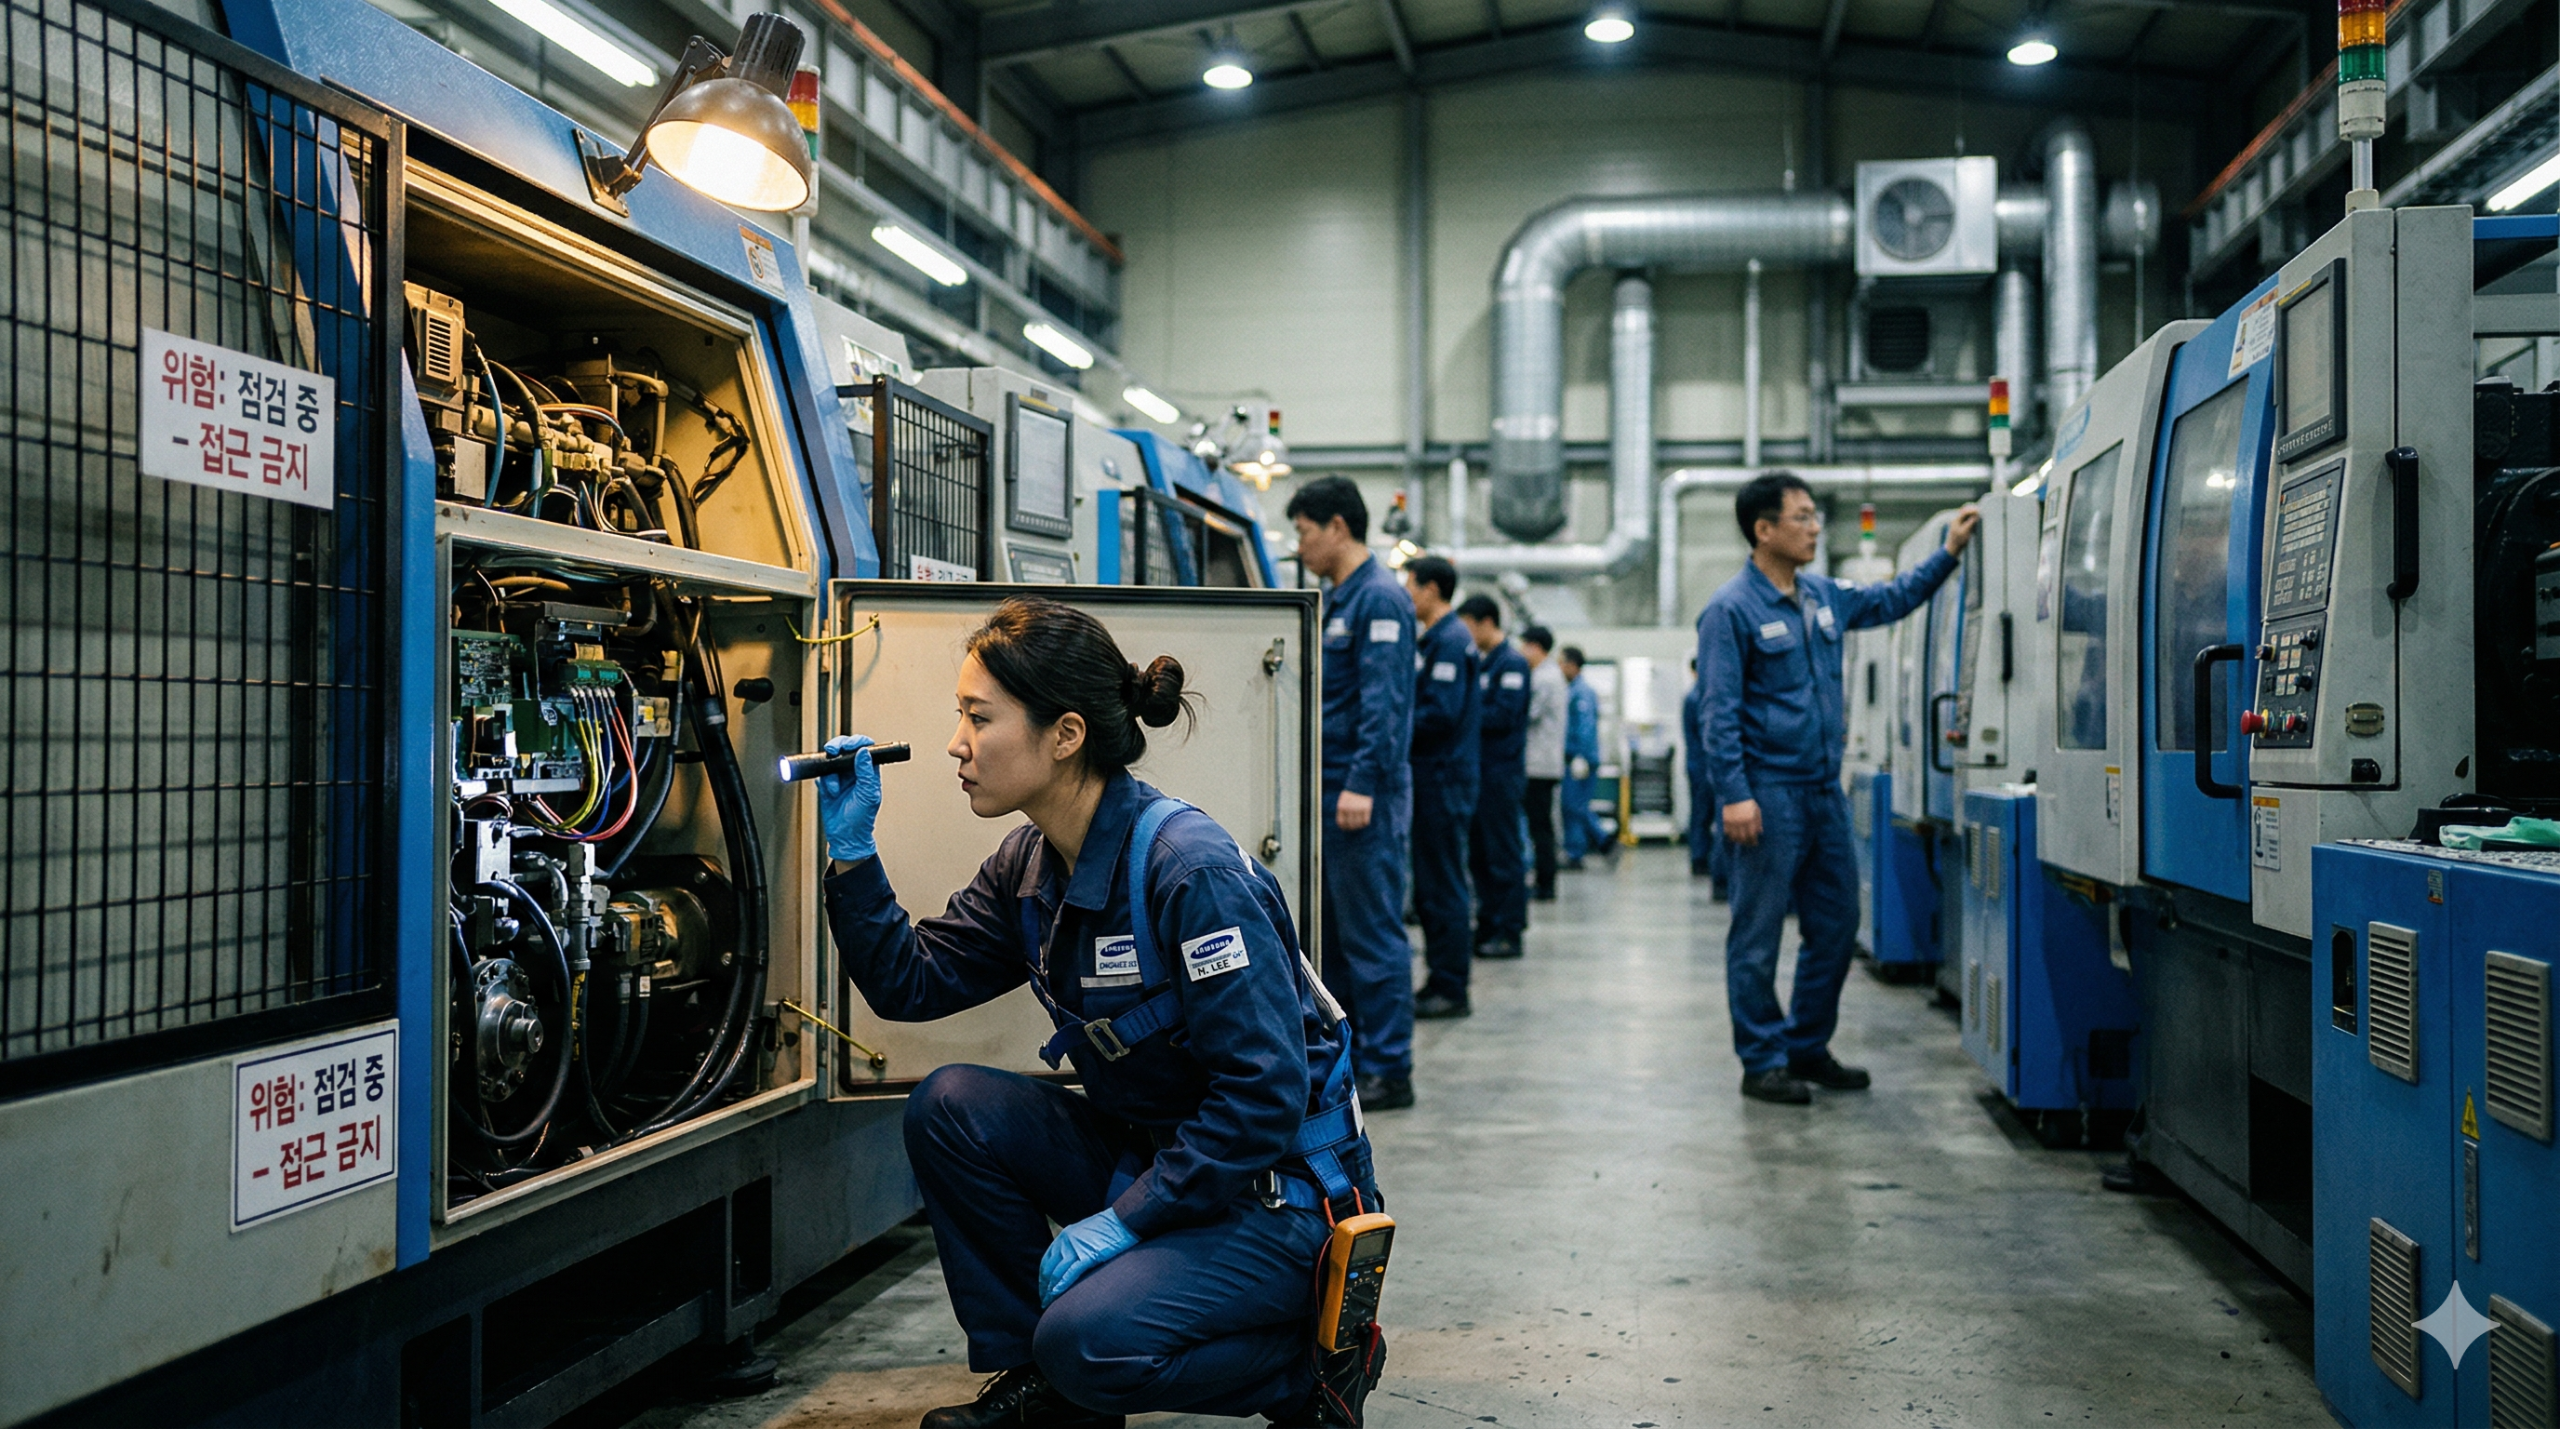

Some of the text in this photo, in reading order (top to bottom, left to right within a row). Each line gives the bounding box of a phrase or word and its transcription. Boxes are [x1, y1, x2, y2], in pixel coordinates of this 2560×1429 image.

[161, 349, 319, 434] 위험: 점검 중
[199, 422, 251, 479] 접근
[260, 435, 308, 491] 금지
[1210, 959, 1231, 972] LEE
[250, 1054, 385, 1132] 위험: 점검 중
[280, 1131, 327, 1190] 접근
[336, 1114, 381, 1172] 금지
